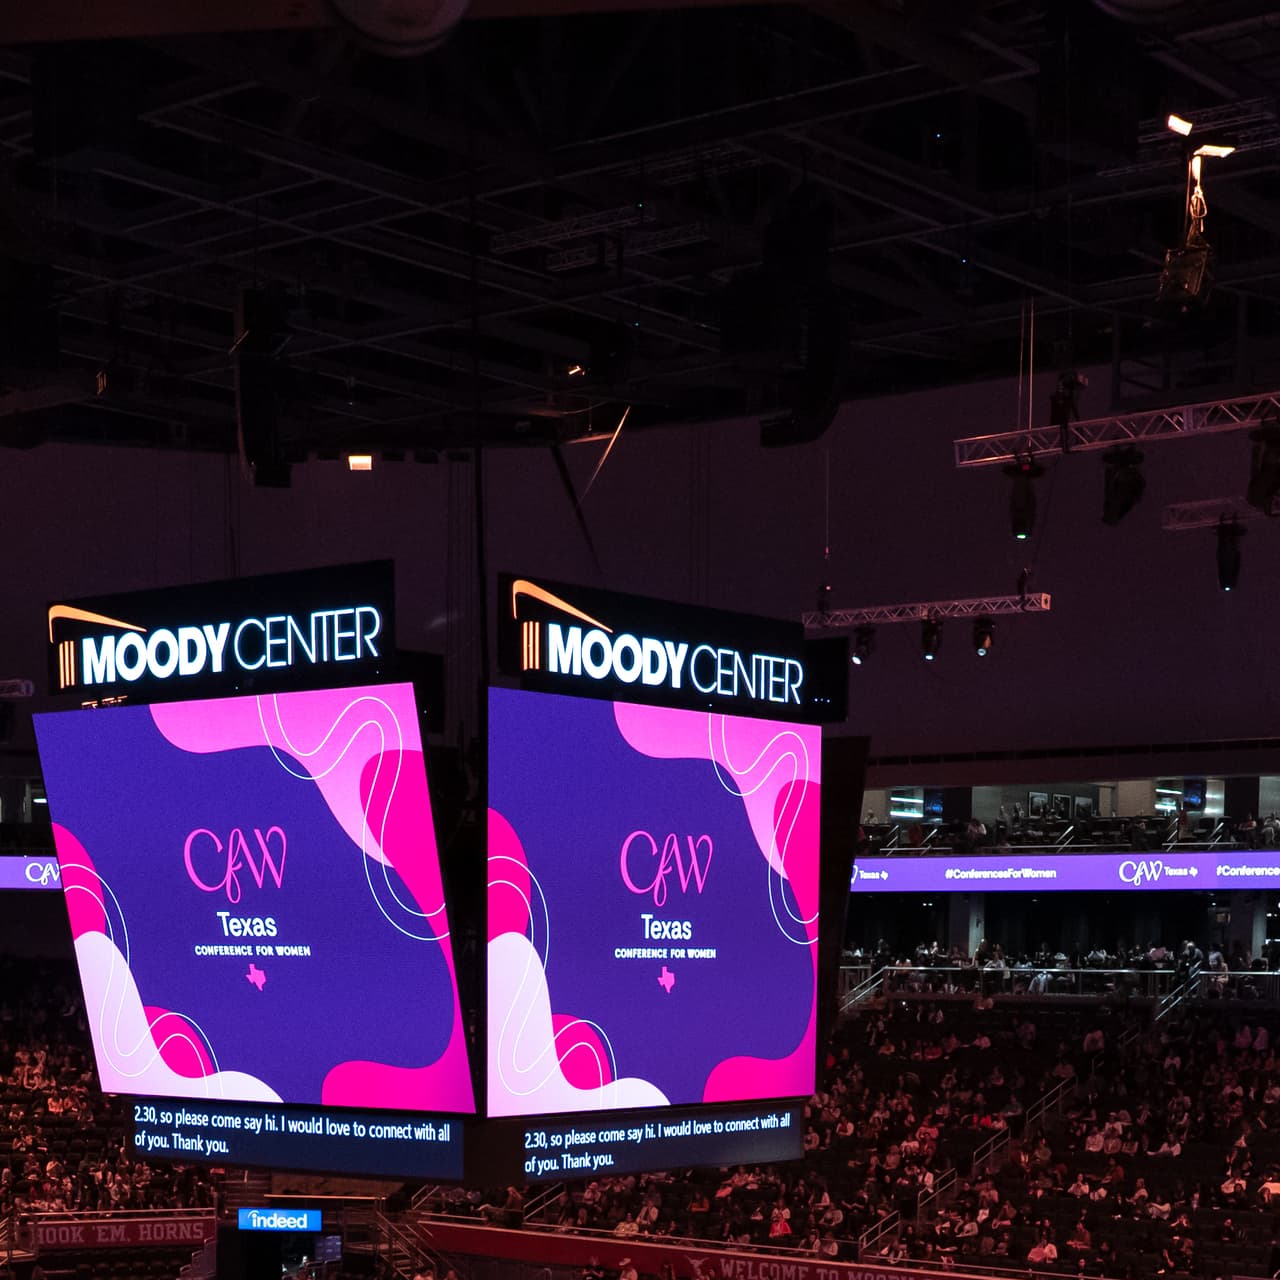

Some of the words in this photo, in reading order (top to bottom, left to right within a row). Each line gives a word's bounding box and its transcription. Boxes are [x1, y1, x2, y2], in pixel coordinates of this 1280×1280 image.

[82, 622, 230, 685] MOODY
[234, 606, 380, 670] CENTER
[548, 623, 688, 688] MOODY
[690, 644, 803, 704] CENTER
[945, 867, 1056, 880] #ConferencesForWomen
[216, 911, 278, 937] Texas
[641, 913, 692, 940] Texas
[194, 945, 253, 956] CONFERENCE
[255, 946, 274, 956] FOR
[275, 946, 311, 957] WOMEN
[614, 948, 668, 959] CONFERENCE
[670, 949, 686, 959] FOR
[687, 949, 717, 959] WOMEN
[134, 1105, 158, 1125] 2.30,
[160, 1111, 172, 1124] so
[175, 1110, 209, 1128] please
[211, 1115, 241, 1129] come
[244, 1118, 262, 1134] say
[265, 1114, 278, 1131] hi.
[281, 1115, 285, 1131] I
[288, 1117, 323, 1135] would
[326, 1118, 350, 1136] love
[353, 1122, 366, 1137] to
[369, 1123, 412, 1140] connect
[414, 1123, 436, 1141] with
[438, 1124, 450, 1142] all
[524, 1132, 548, 1149] 2.30,
[550, 1135, 562, 1147] so
[564, 1129, 596, 1148] please
[598, 1131, 625, 1143] come
[627, 1129, 643, 1144] say
[645, 1124, 656, 1139] hi.
[658, 1124, 661, 1138] I
[663, 1121, 691, 1137] would
[693, 1119, 712, 1135] love
[713, 1120, 723, 1133] to
[725, 1117, 759, 1132] connect
[761, 1115, 779, 1129] with
[780, 1113, 791, 1127] all
[135, 1131, 147, 1147] of
[147, 1135, 170, 1151] you.
[172, 1133, 204, 1152] Thank
[206, 1138, 229, 1156] you.
[524, 1155, 536, 1172] of
[537, 1159, 559, 1175] you.
[561, 1153, 591, 1169] Thank
[592, 1155, 614, 1173] you.
[248, 1210, 308, 1229] indeed
[36, 1226, 85, 1245] HOOK
[138, 1222, 204, 1241] HORNS
